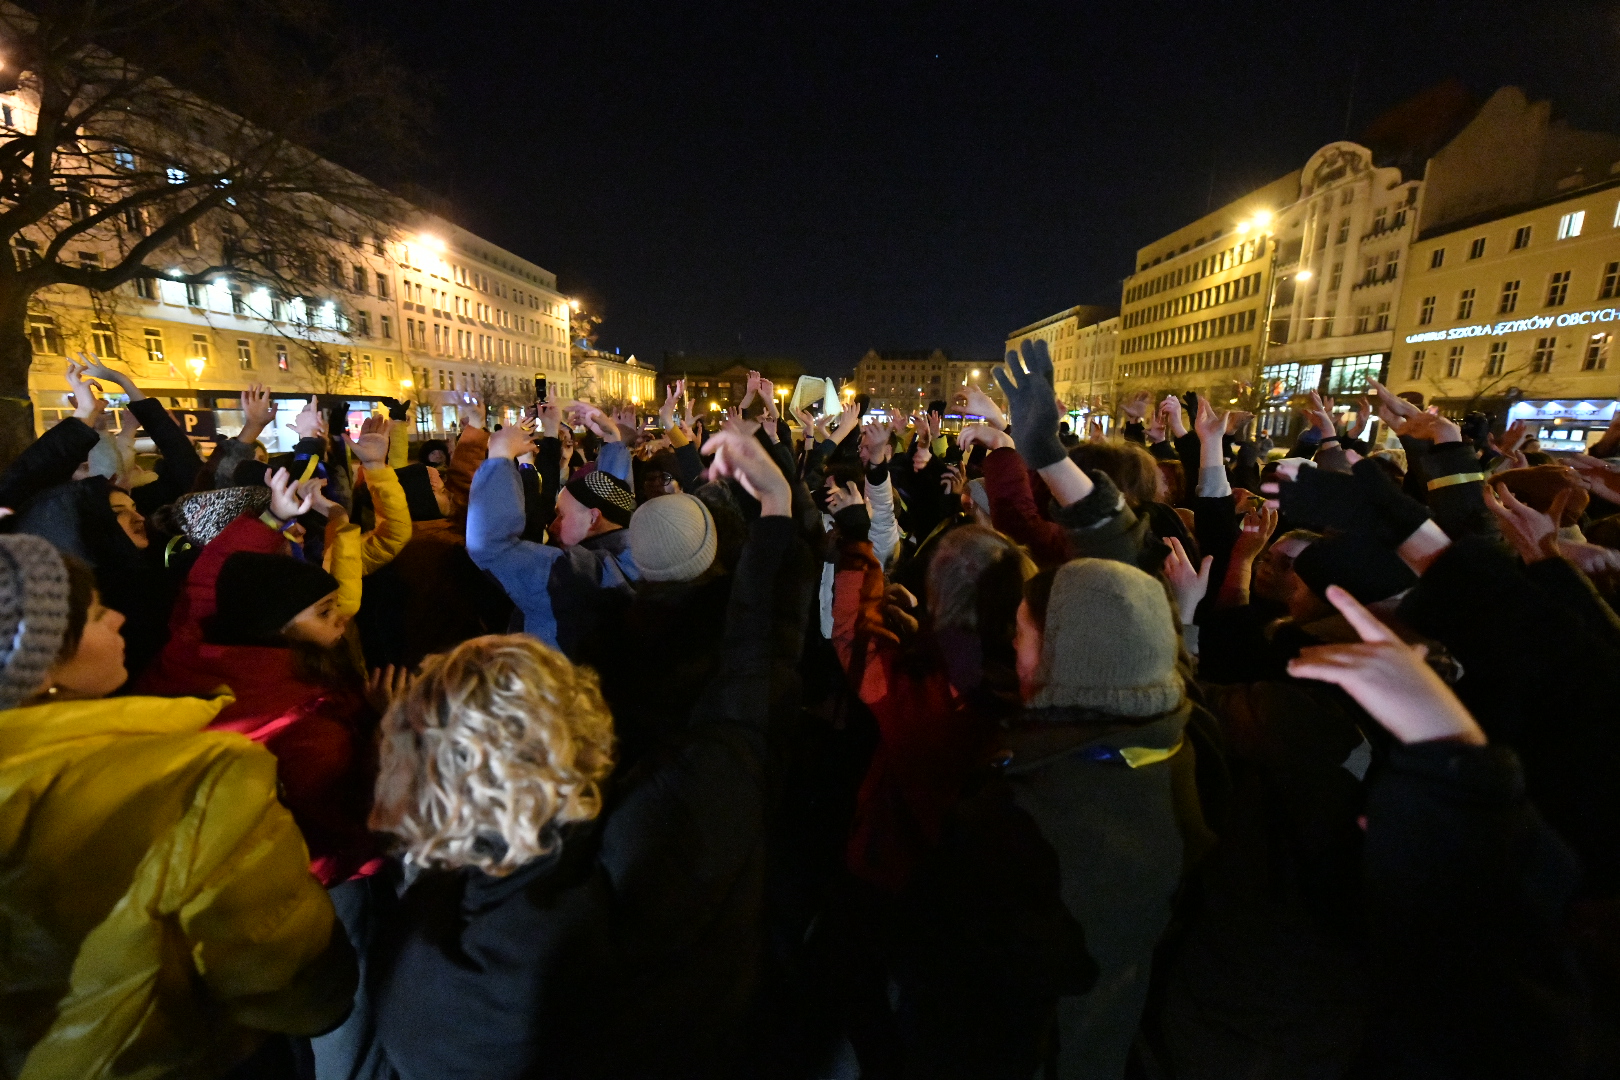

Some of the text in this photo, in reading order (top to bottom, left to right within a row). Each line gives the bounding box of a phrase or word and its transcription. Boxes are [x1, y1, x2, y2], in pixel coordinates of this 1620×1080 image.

[1447, 324, 1492, 339] SZKOŁA
[1556, 308, 1620, 327] OBCYCH
[184, 413, 198, 433] P
[647, 416, 654, 424] P
